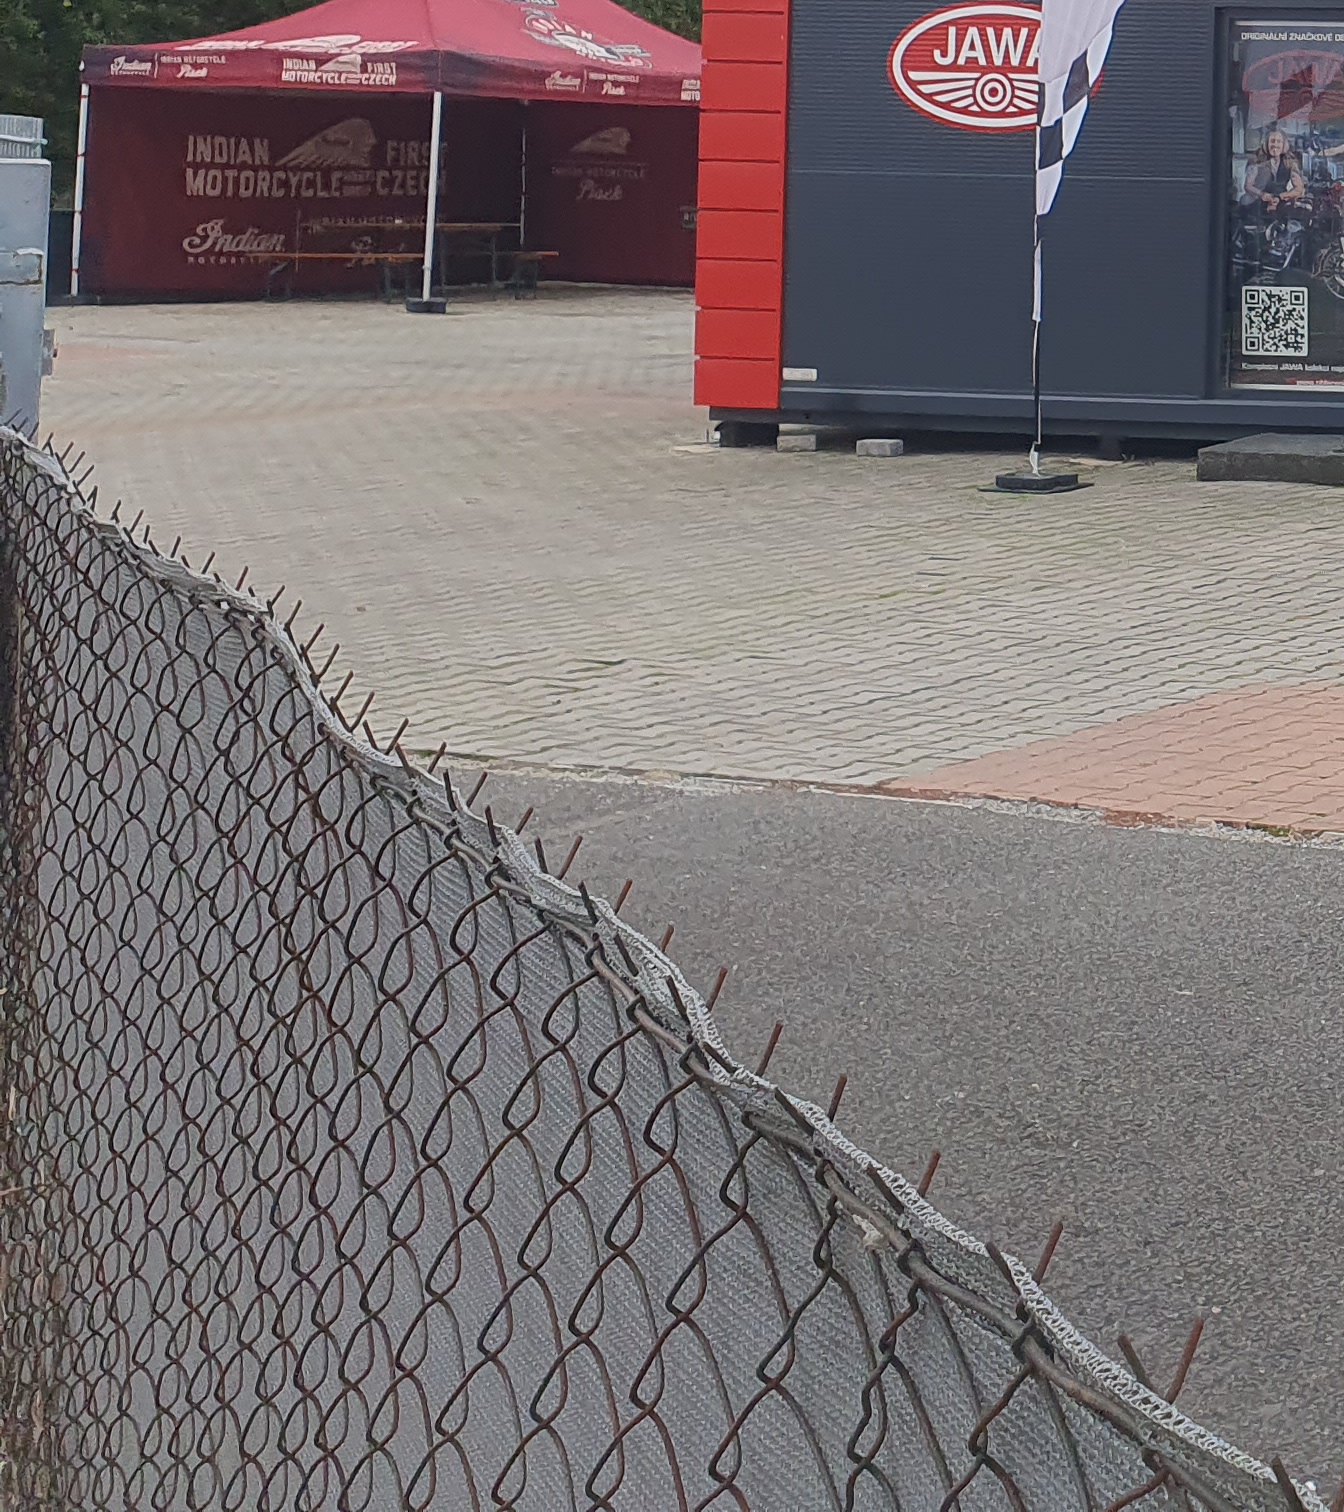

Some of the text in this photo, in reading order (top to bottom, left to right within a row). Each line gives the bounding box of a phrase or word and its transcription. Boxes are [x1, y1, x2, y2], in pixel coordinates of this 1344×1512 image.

[186, 135, 270, 166] INDIAN
[185, 167, 344, 198] MOTORCYCLE
[183, 219, 286, 254] Indian
